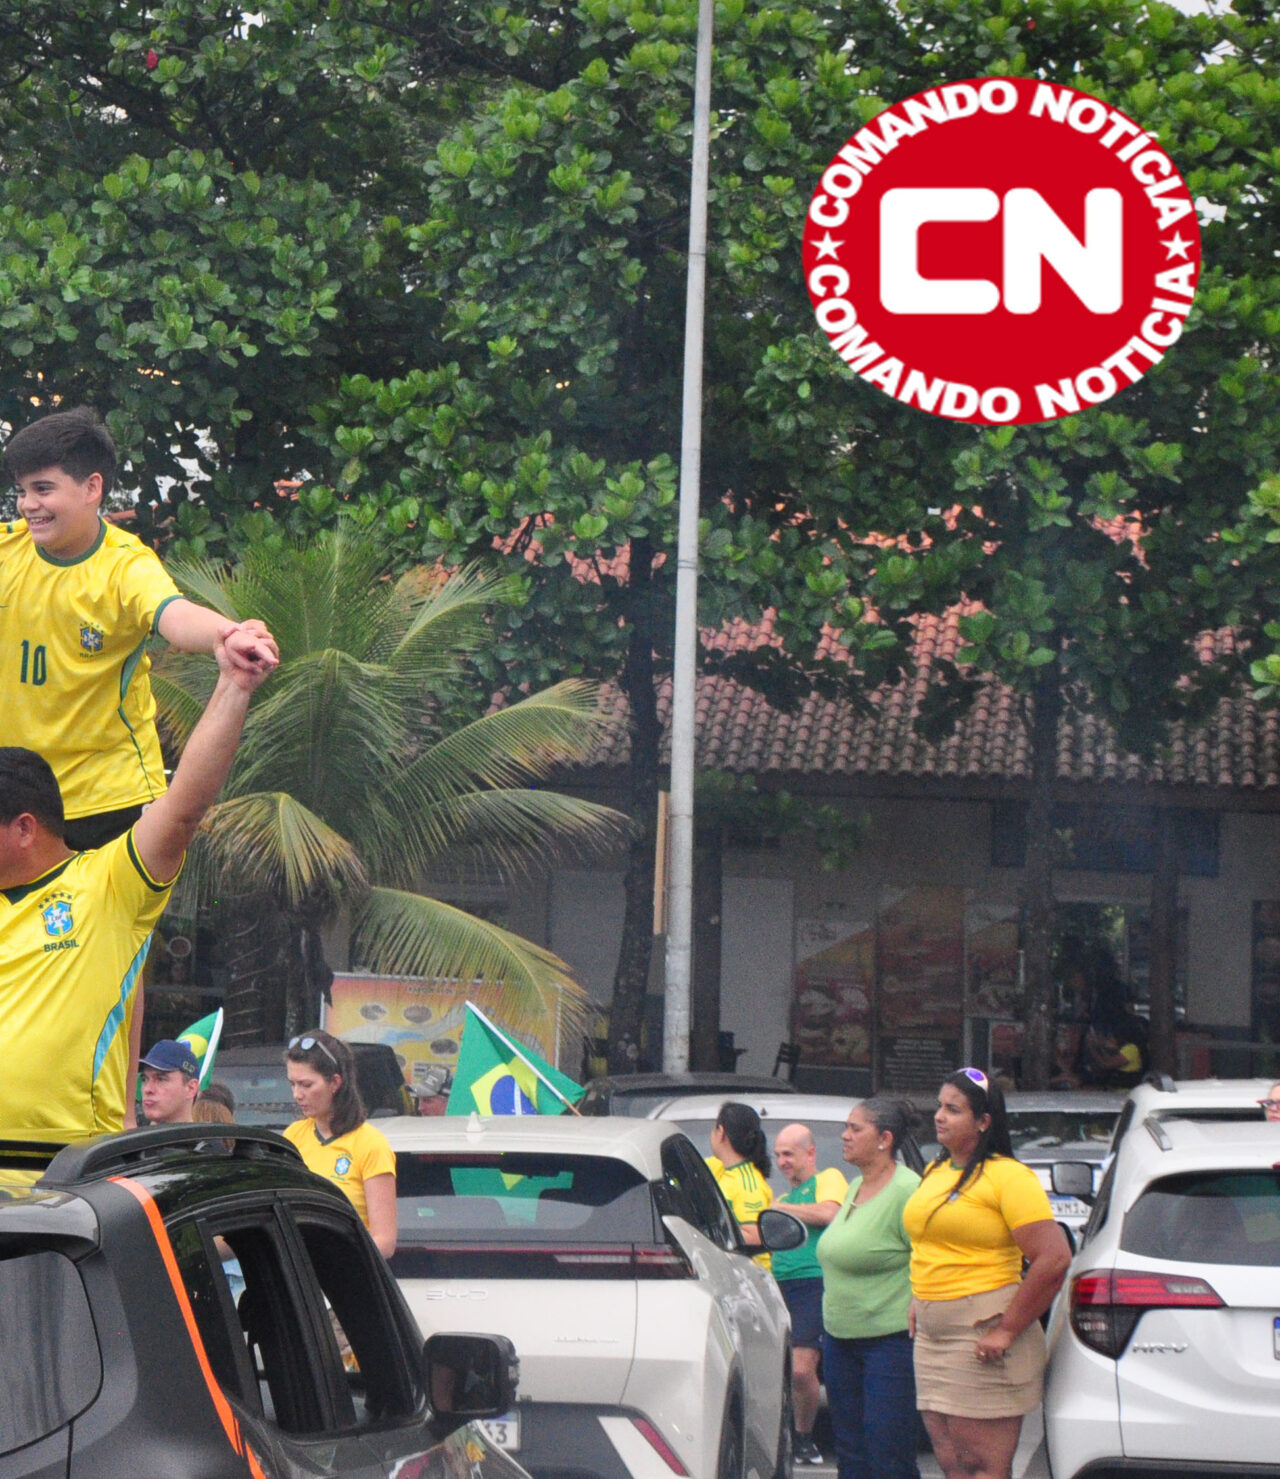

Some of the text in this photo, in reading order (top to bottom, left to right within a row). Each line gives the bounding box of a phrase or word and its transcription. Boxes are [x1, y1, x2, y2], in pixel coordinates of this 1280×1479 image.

[20, 640, 47, 686] 10
[44, 939, 80, 952] BRASIL
[425, 1288, 488, 1300] BYD
